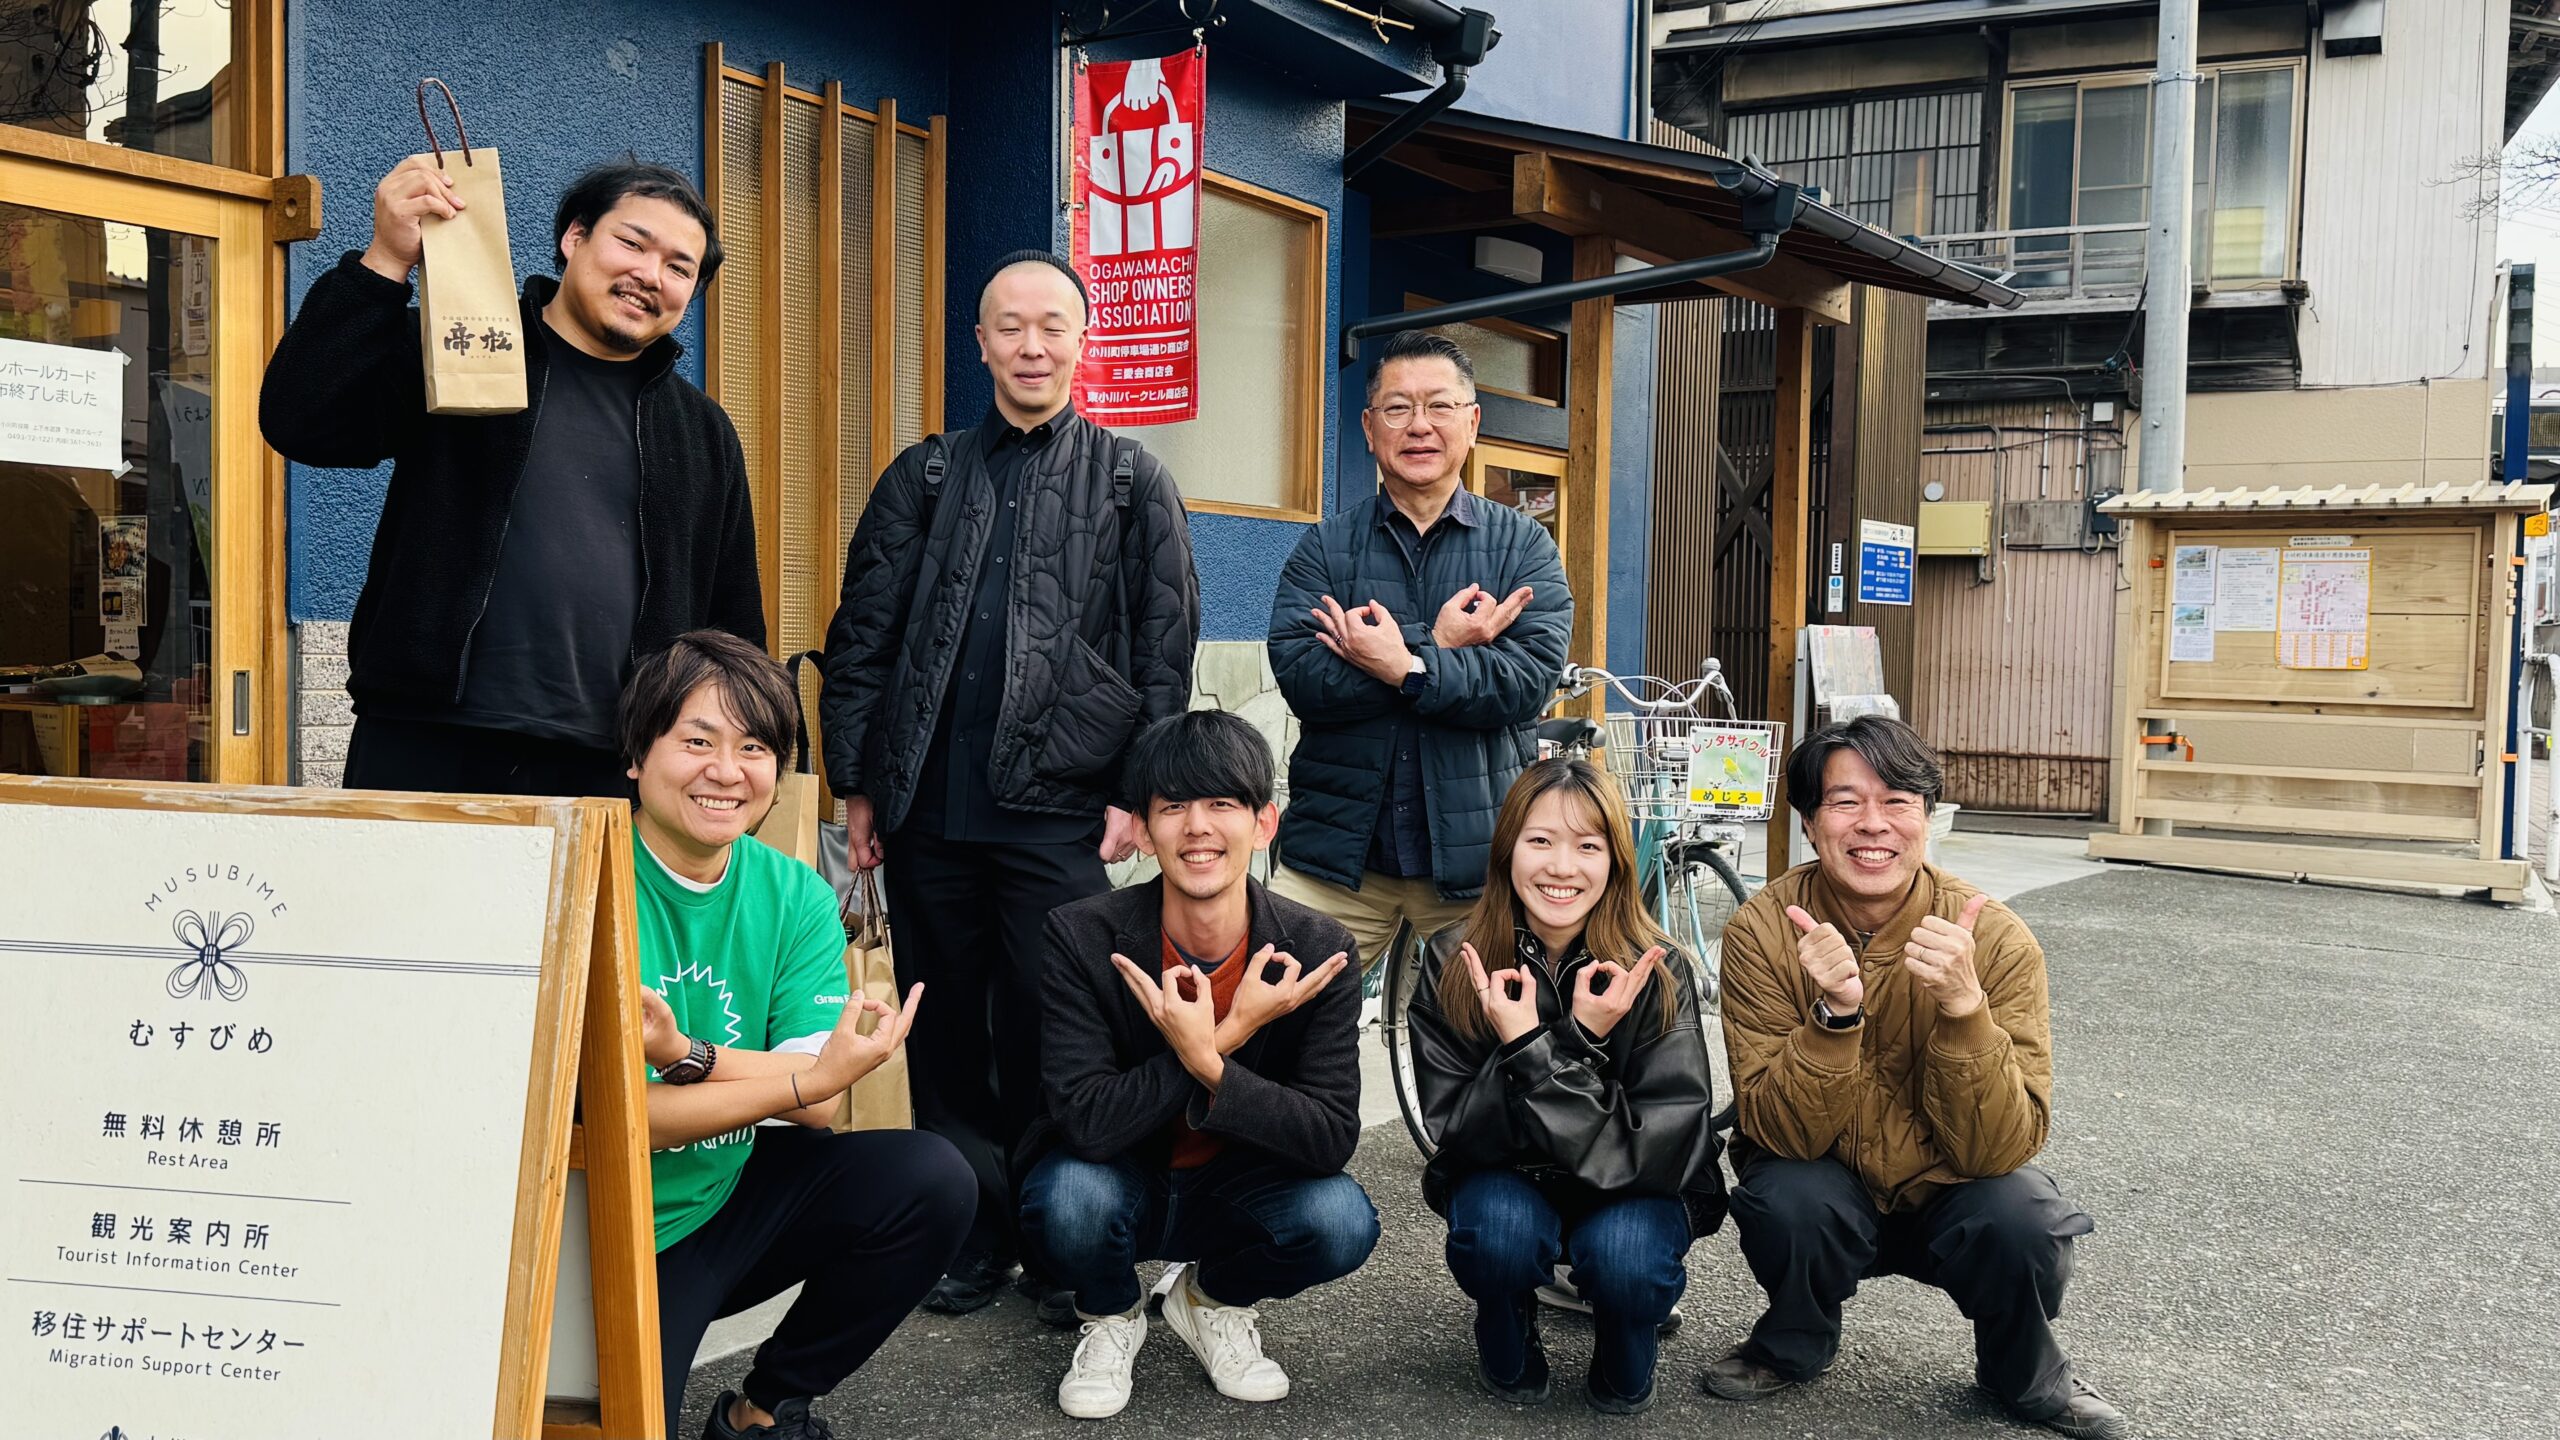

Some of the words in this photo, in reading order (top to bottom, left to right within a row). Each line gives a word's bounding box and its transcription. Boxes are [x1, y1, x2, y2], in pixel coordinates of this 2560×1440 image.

[1089, 254, 1192, 280] OGAWAMACHI
[1089, 281, 1129, 304] SHOP
[1132, 274, 1192, 301] OWNERS
[1089, 299, 1191, 328] ASSOCIATION
[1692, 735, 1769, 758] レンタサイクル
[1703, 791, 1748, 803] めじろ
[144, 863, 288, 918] MUSUBIME
[129, 1019, 274, 1054] むすびめ
[102, 1111, 282, 1149] 無料休憩所
[91, 1211, 270, 1251] 観光案内所
[57, 1246, 118, 1265] Tourist
[126, 1251, 231, 1273] Information
[238, 1259, 300, 1278] Center
[32, 1310, 305, 1354] 移住サポートセンター
[49, 1348, 134, 1369] Migration
[141, 1355, 213, 1377] Support
[220, 1362, 281, 1381] Center
